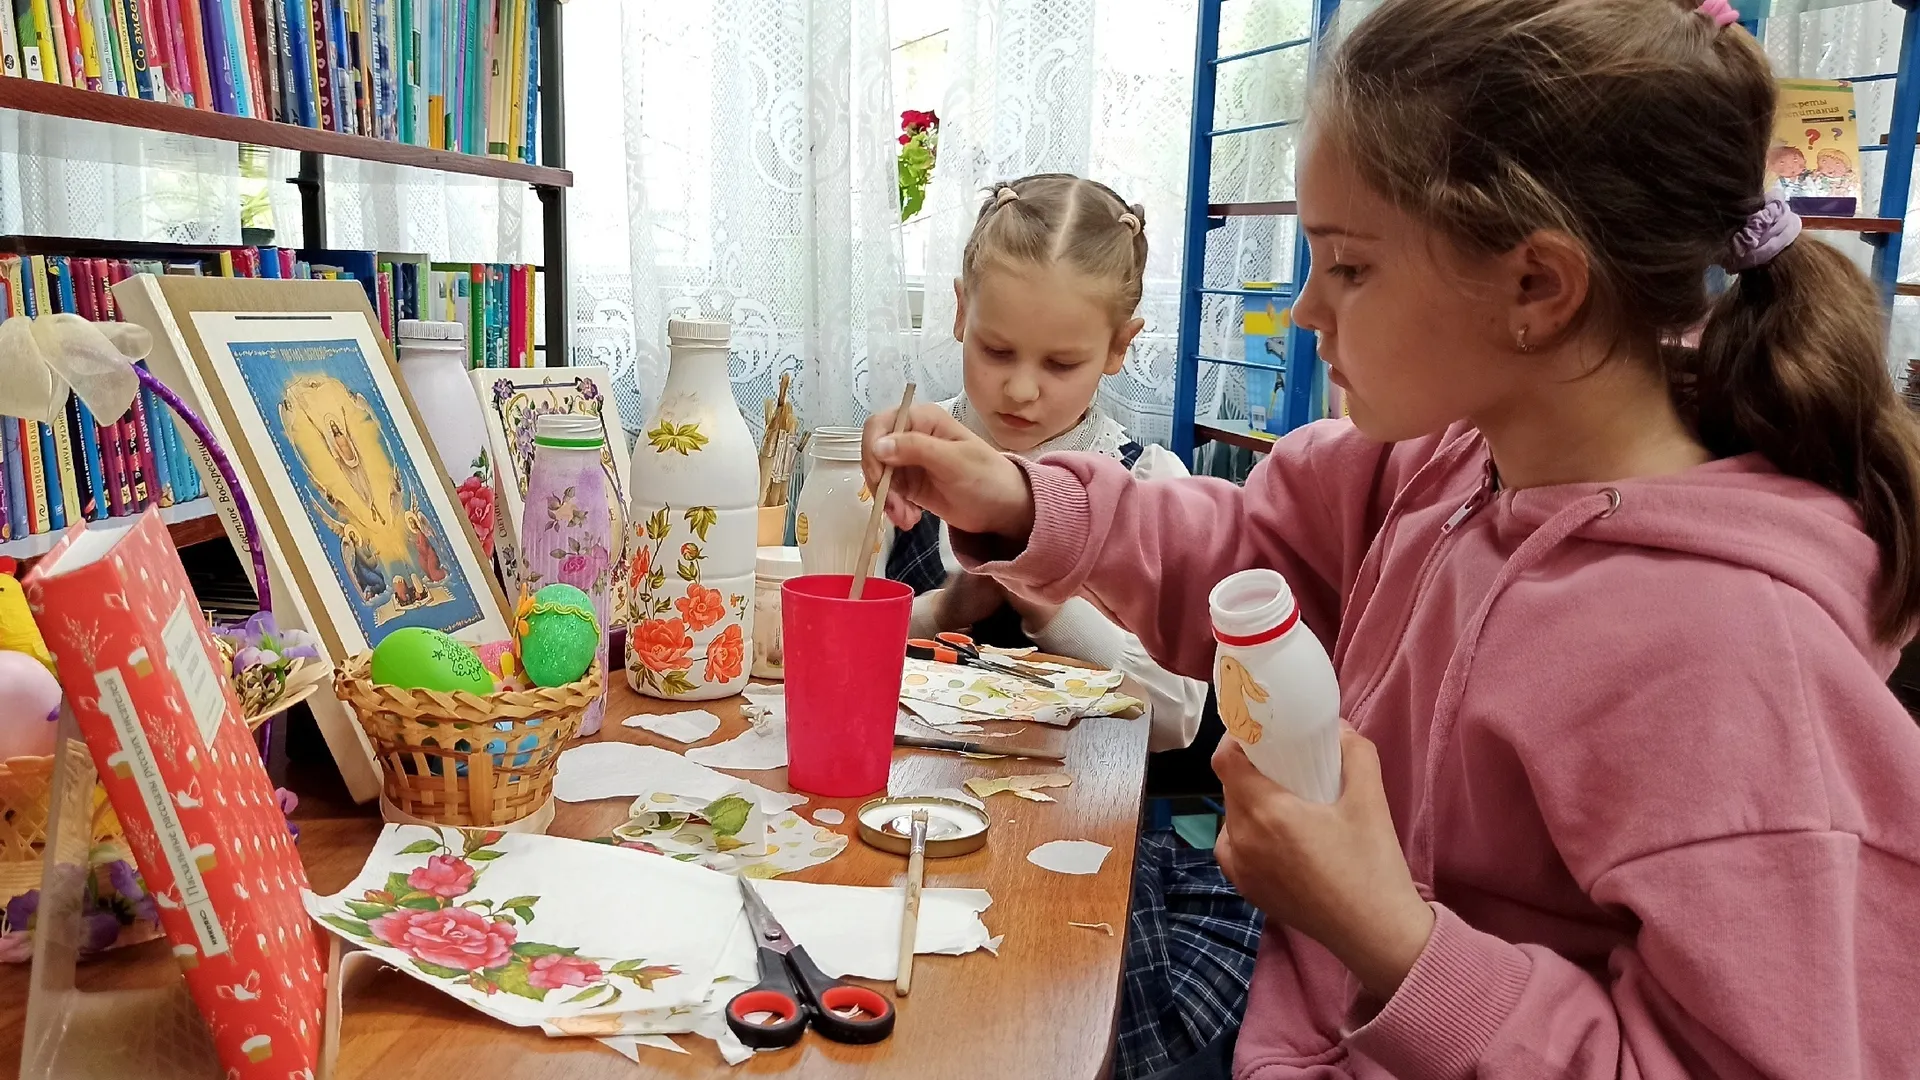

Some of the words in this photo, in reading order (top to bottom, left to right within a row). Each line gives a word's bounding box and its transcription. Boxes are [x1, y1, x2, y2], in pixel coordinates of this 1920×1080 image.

[130, 0, 142, 45] змее
[135, 48, 147, 72] Со
[374, 73, 382, 110] ДРУЗЬЯ
[140, 413, 152, 454] ЗАГАДКА
[32, 455, 44, 499] ВОРОВСТВО
[62, 446, 72, 473] УЛИКА
[194, 438, 231, 504] Воскресение
[226, 507, 253, 554] Светлое
[104, 676, 136, 732] писателей
[130, 733, 156, 779] русских
[149, 779, 178, 832] рассказы
[169, 831, 201, 899] Пасхальные
